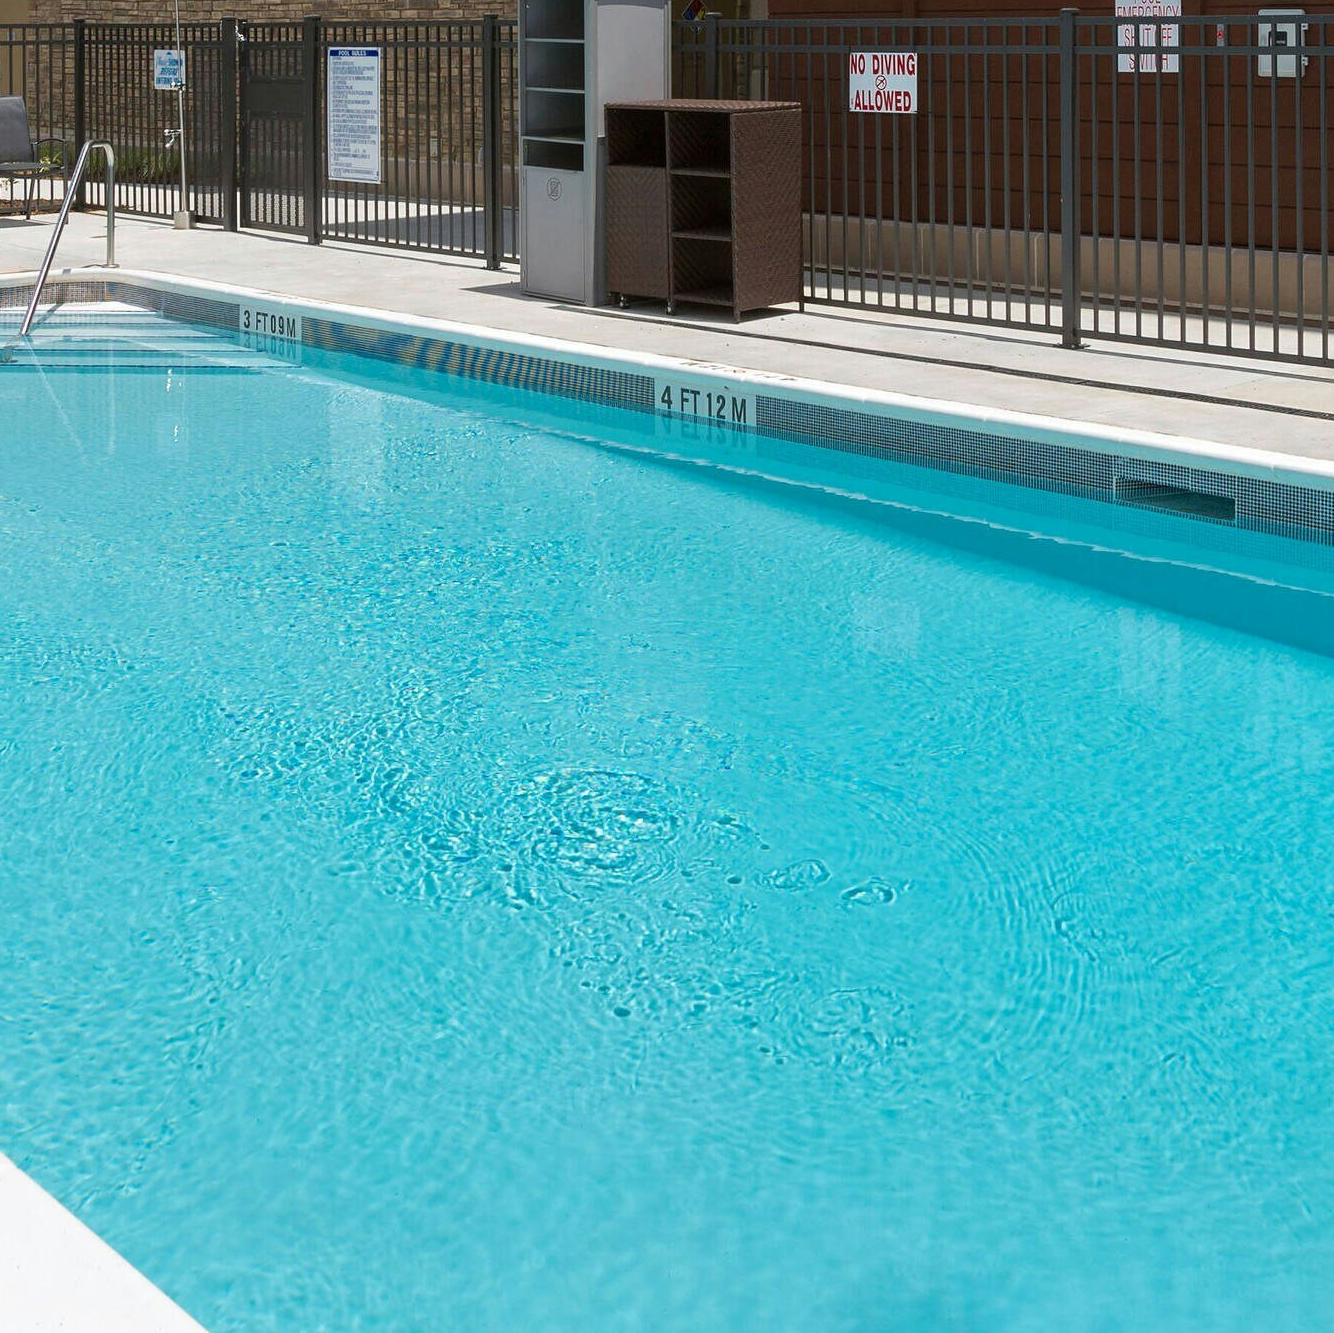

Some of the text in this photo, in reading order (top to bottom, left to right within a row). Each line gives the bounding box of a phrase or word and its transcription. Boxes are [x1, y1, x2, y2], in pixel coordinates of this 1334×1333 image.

[850, 54, 915, 75] NO DIVING
[855, 90, 911, 111] ALLOWED
[244, 310, 250, 328] 3
[256, 312, 268, 332] FT
[661, 386, 672, 409] 4
[680, 388, 700, 414] FT
